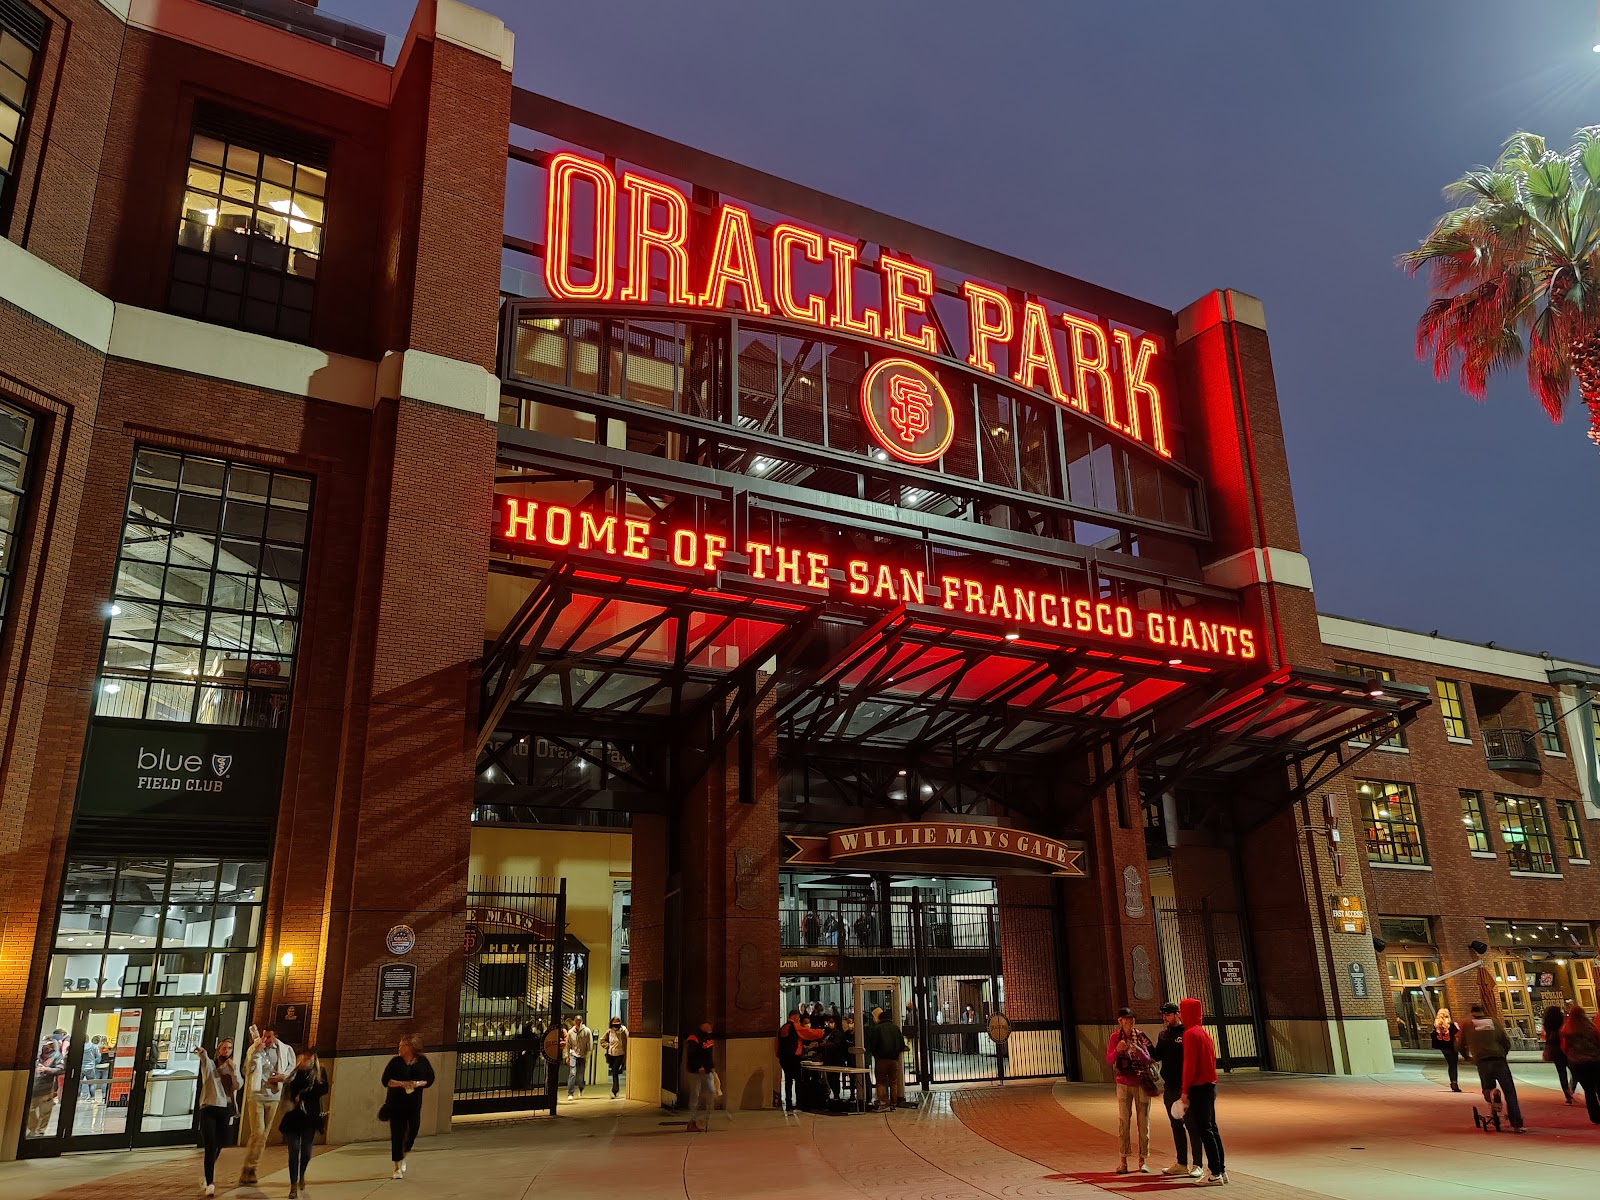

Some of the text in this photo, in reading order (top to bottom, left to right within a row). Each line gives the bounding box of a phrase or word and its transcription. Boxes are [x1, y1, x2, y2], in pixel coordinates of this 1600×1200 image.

[545, 152, 1172, 459] ORACLE PARK
[505, 498, 1257, 660] HOME OF THE SAN FRANCISCO GIANTS
[137, 746, 203, 772] blue
[137, 776, 223, 792] FIELD CLUB
[839, 827, 1068, 863] WILLIE MAYS GATE
[485, 910, 534, 929] MAYS
[810, 960, 828, 968] RAMP
